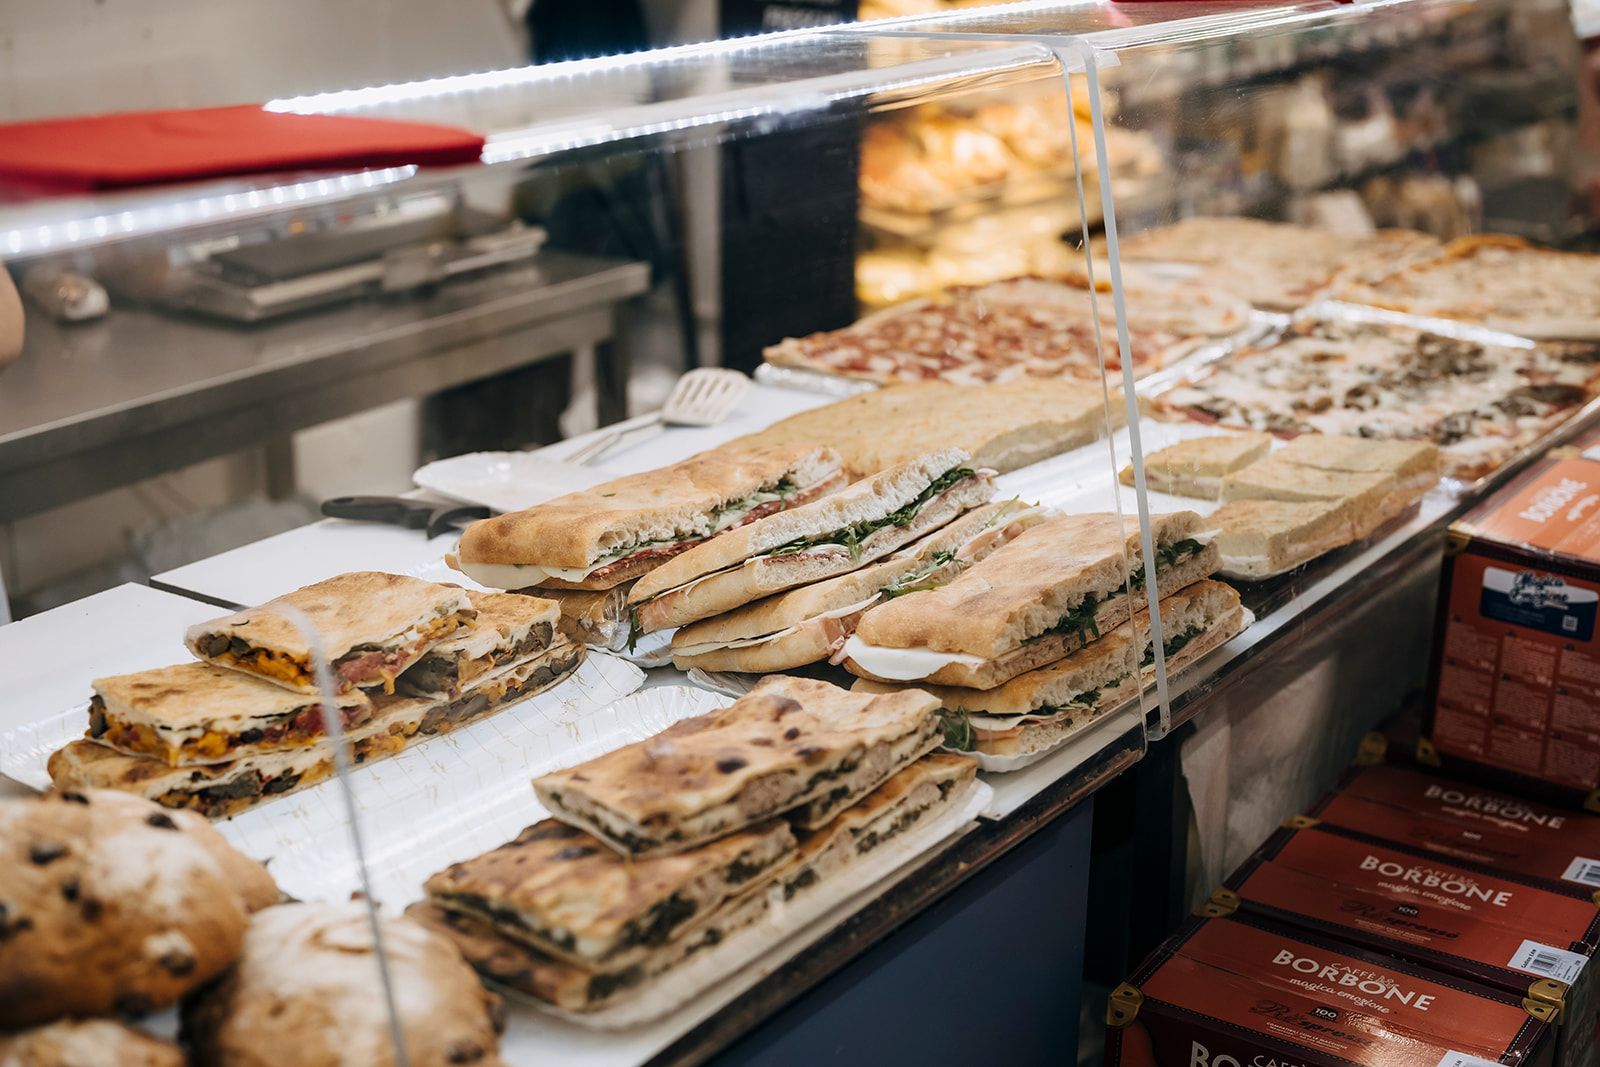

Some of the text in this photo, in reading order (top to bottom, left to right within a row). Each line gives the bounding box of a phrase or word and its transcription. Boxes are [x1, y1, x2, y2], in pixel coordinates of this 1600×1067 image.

[1424, 785, 1566, 829] BORBONE
[1359, 855, 1513, 907] BORBONE
[1272, 949, 1436, 1011] BORBONE
[1331, 962, 1375, 982] CAFFÈ
[1289, 978, 1390, 1014] magica emozione
[1315, 1007, 1337, 1018] 100
